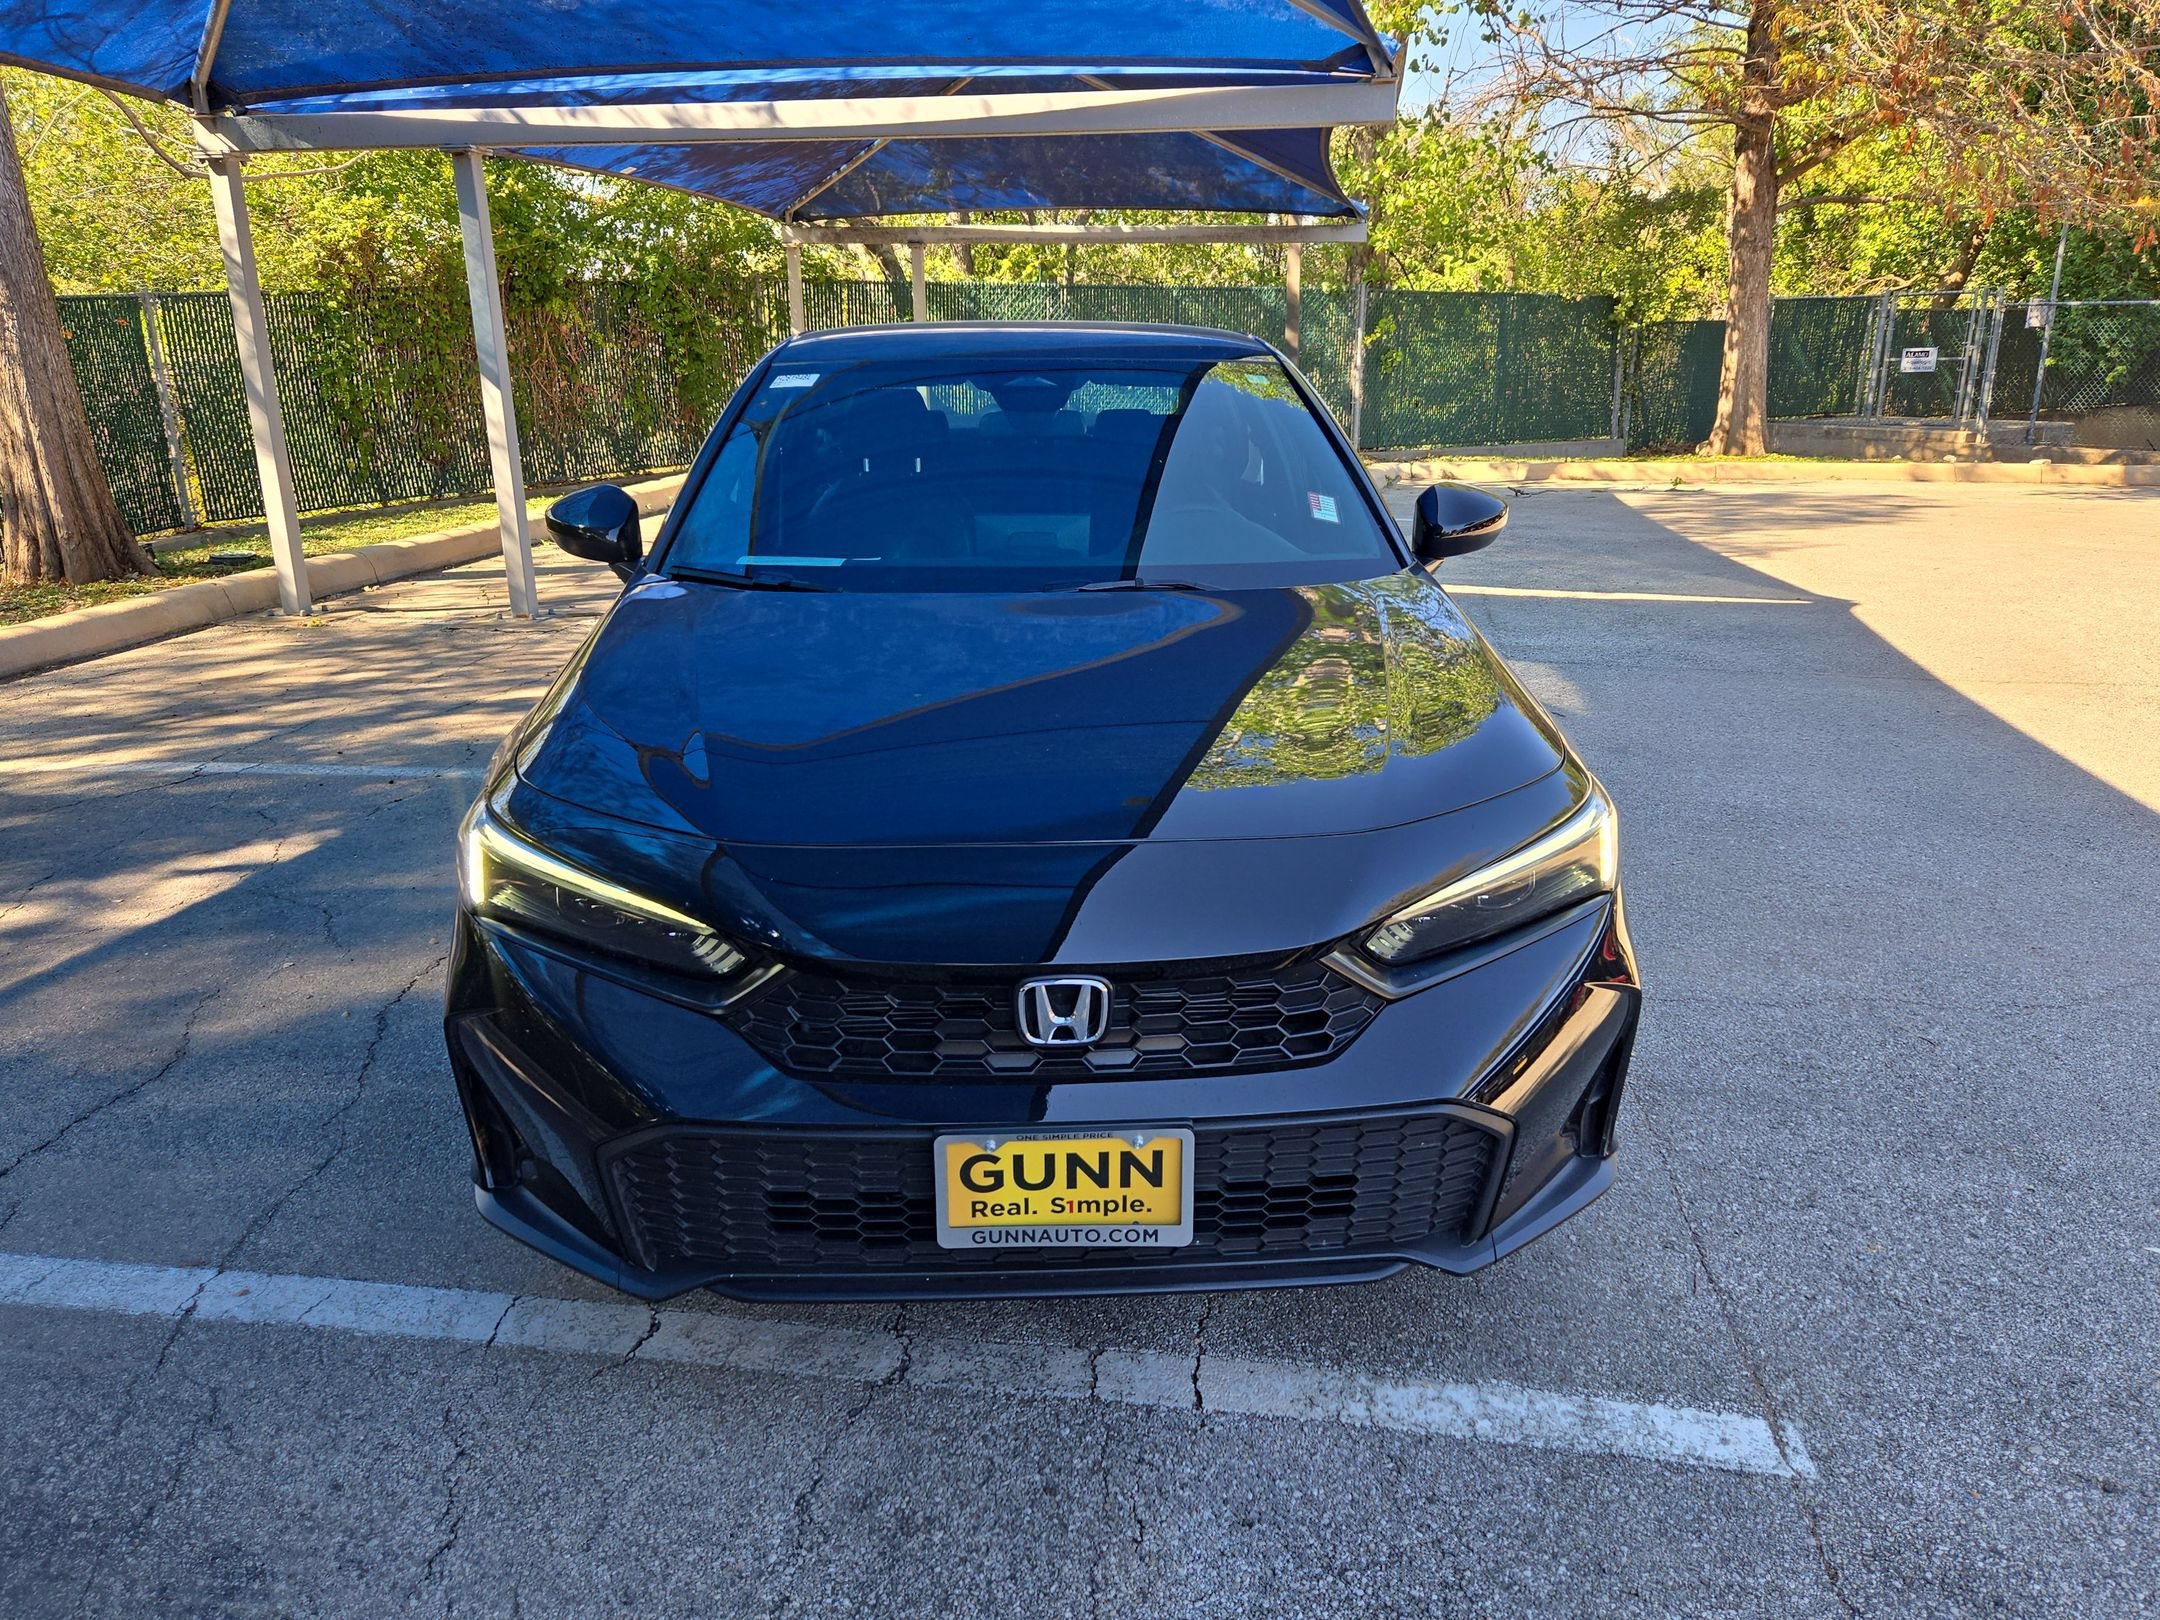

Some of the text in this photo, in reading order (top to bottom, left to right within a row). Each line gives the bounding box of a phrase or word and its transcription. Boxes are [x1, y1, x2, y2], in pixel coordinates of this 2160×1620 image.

[1042, 1133, 1080, 1141] SIMPLE
[1082, 1131, 1114, 1140] PRICE
[959, 1149, 1164, 1193] GUNN
[971, 1195, 1152, 1218] Real. S1mple.
[971, 1229, 1159, 1244] GUNNAUTO.COM
